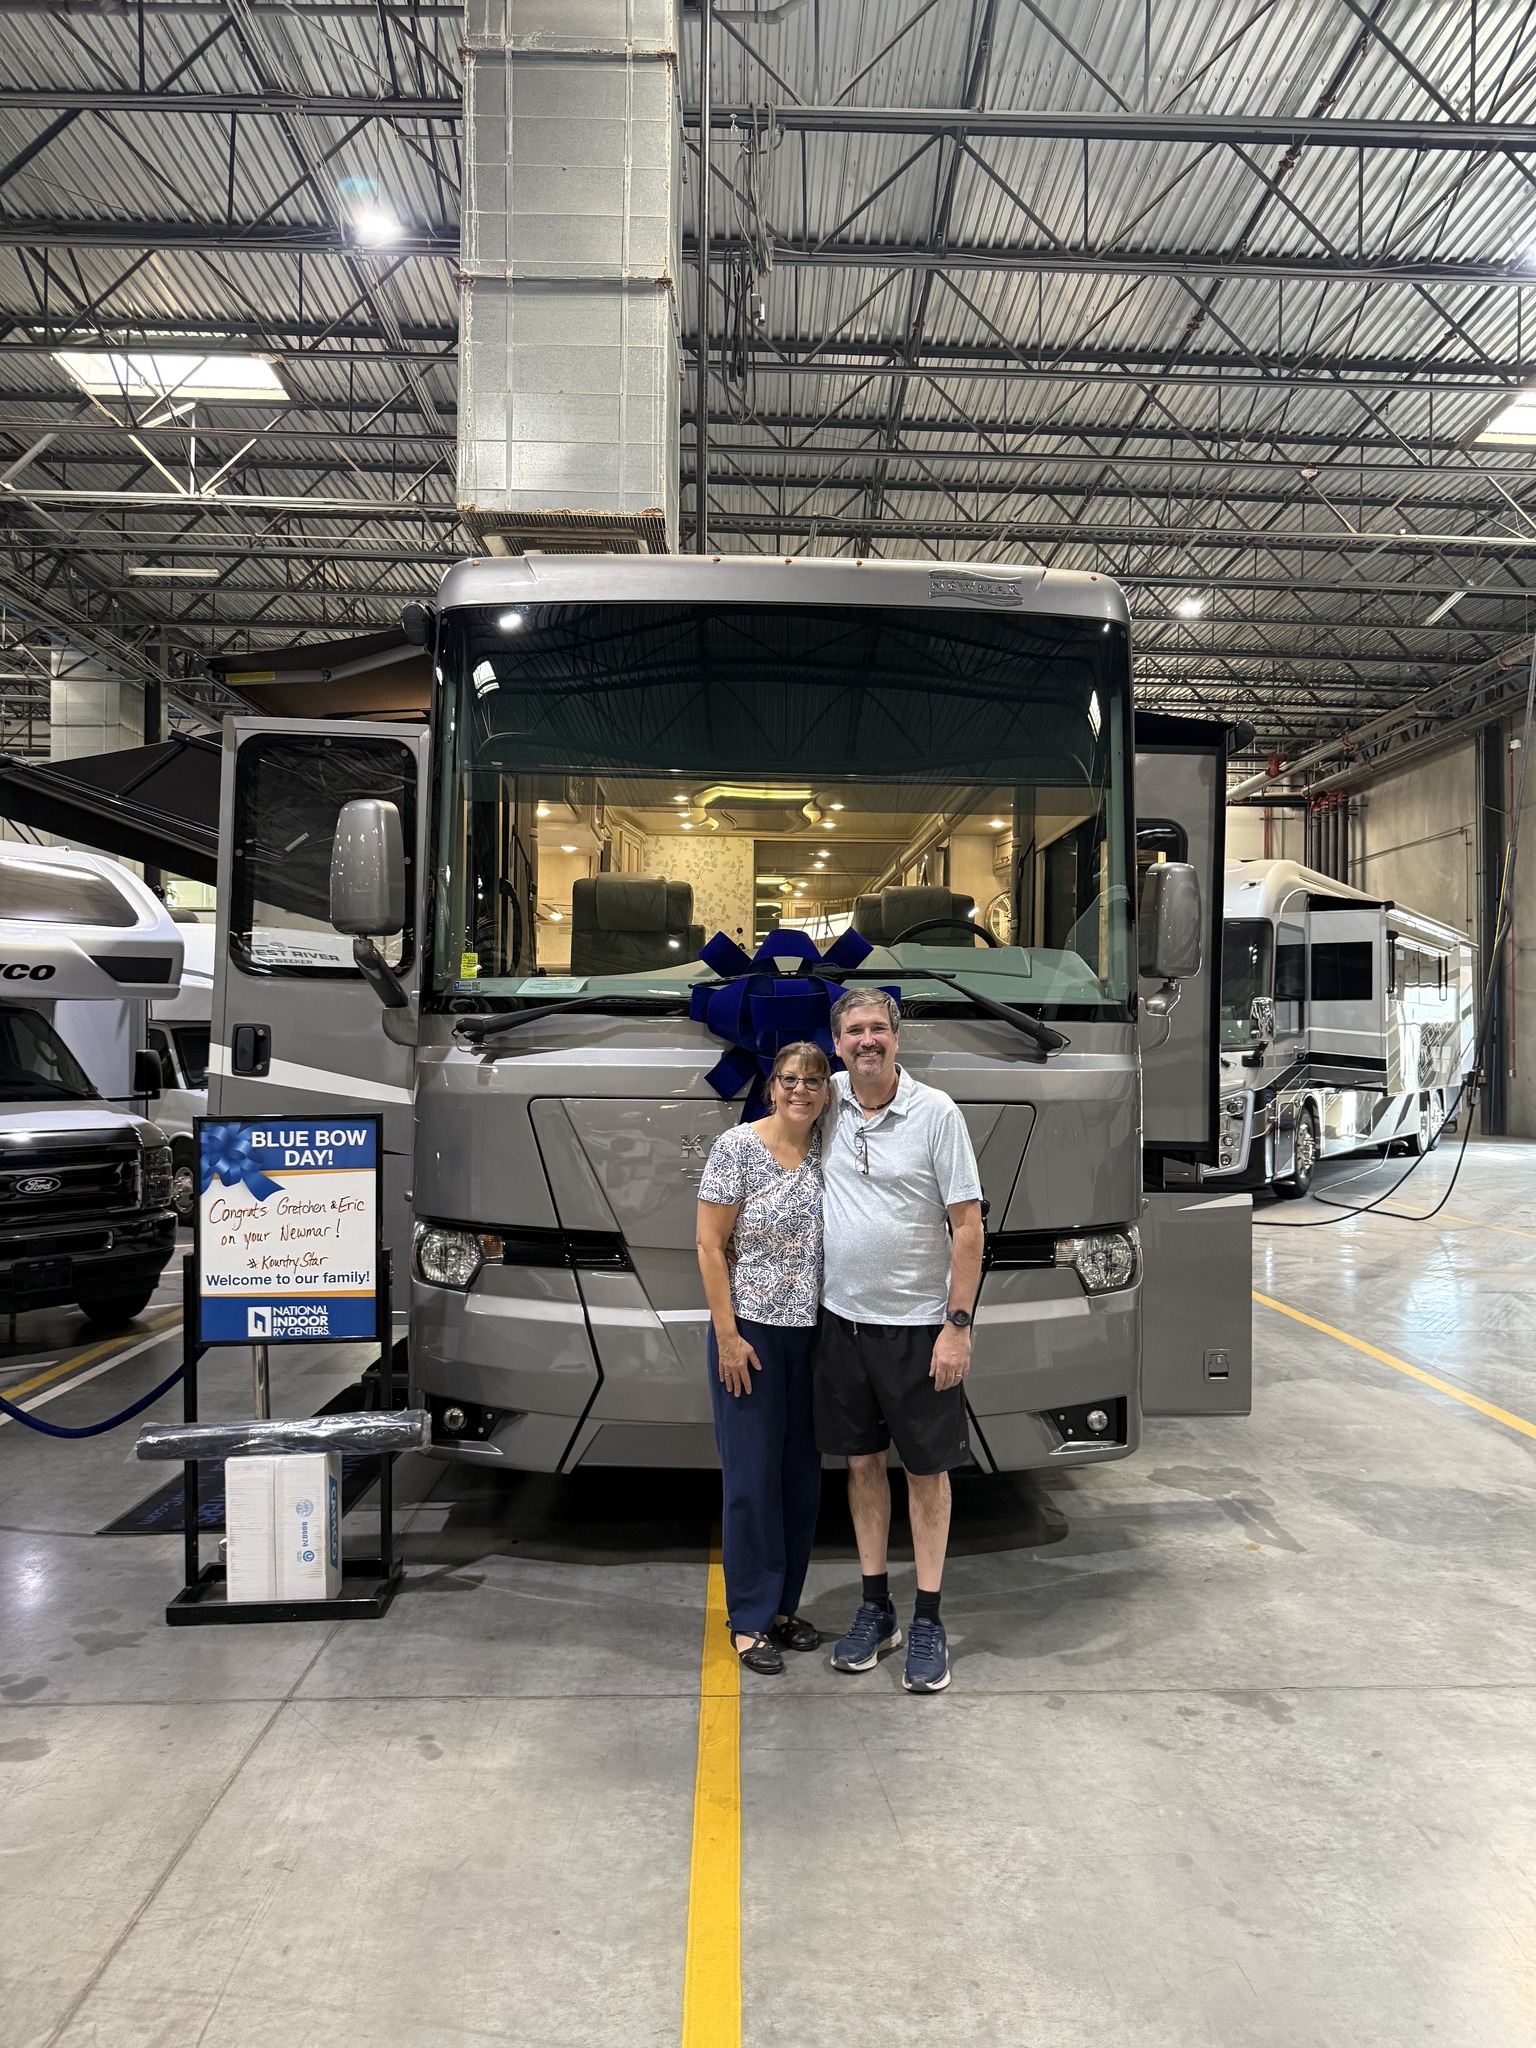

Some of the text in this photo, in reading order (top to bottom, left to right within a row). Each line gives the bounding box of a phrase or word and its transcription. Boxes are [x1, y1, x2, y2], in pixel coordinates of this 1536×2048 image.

[931, 580, 1021, 595] NEWMAR
[291, 951, 340, 961] RIVER
[251, 1130, 367, 1148] BLUE BOW
[284, 1150, 333, 1166] DAY!
[25, 1179, 53, 1191] Ford
[209, 1198, 267, 1231] Congrats
[277, 1197, 326, 1216] Gretchen
[221, 1234, 236, 1246] on
[244, 1231, 272, 1250] your
[206, 1271, 370, 1286] Welcome to our family!
[273, 1305, 329, 1316] NATIONAL
[273, 1316, 329, 1327] INDOOR
[273, 1326, 330, 1337] RV CENTERS
